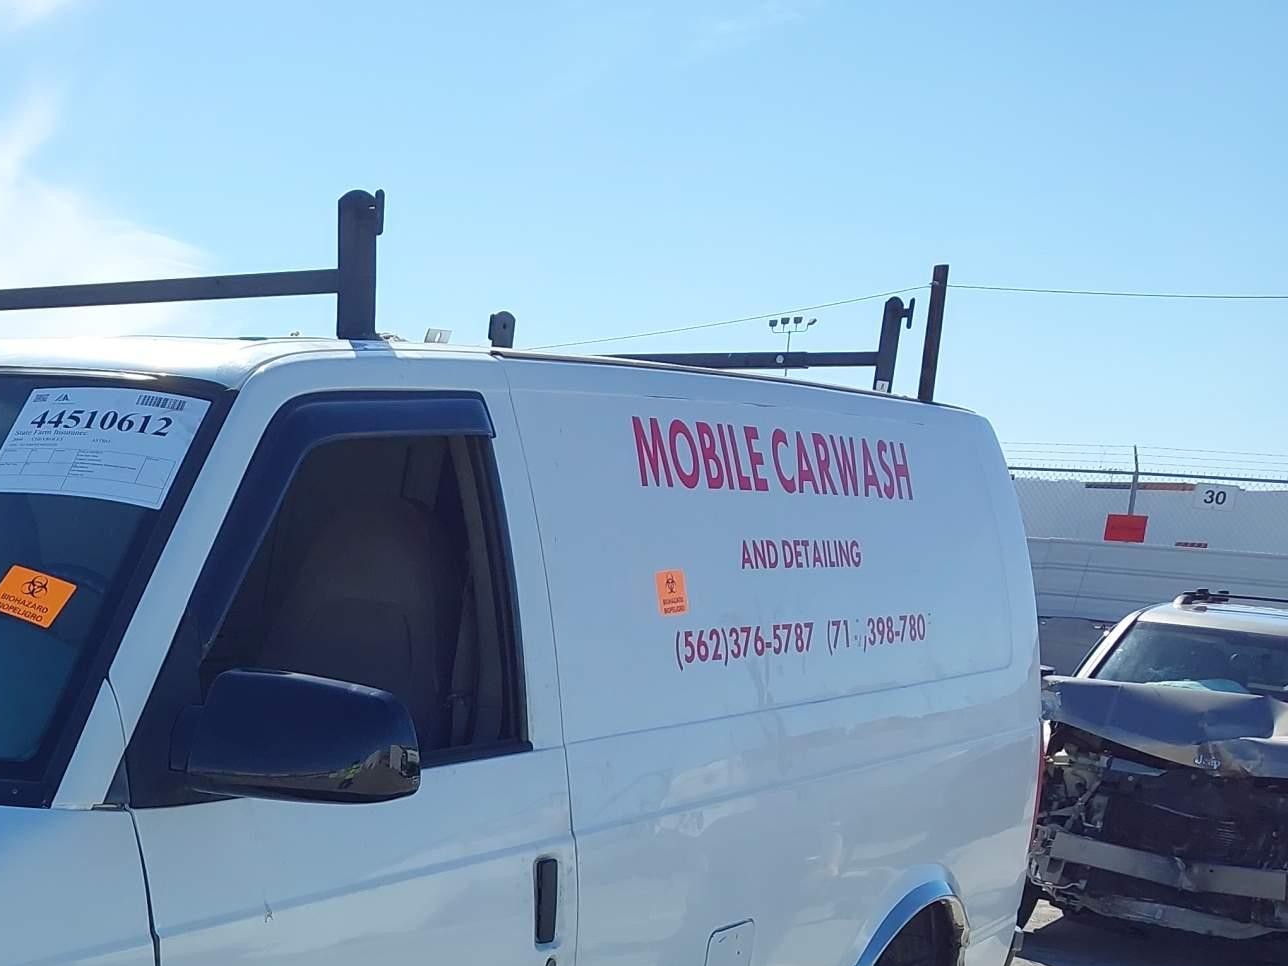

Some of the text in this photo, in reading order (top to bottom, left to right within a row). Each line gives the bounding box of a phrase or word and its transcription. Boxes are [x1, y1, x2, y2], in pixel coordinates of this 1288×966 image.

[31, 410, 173, 437] 44510612
[631, 416, 914, 500] MOBILE CARWASH
[1203, 489, 1227, 505] 30
[741, 539, 862, 569] AND DETAILING
[1, 593, 49, 614] BIOHAZARD
[675, 622, 814, 672] (562)376-5787
